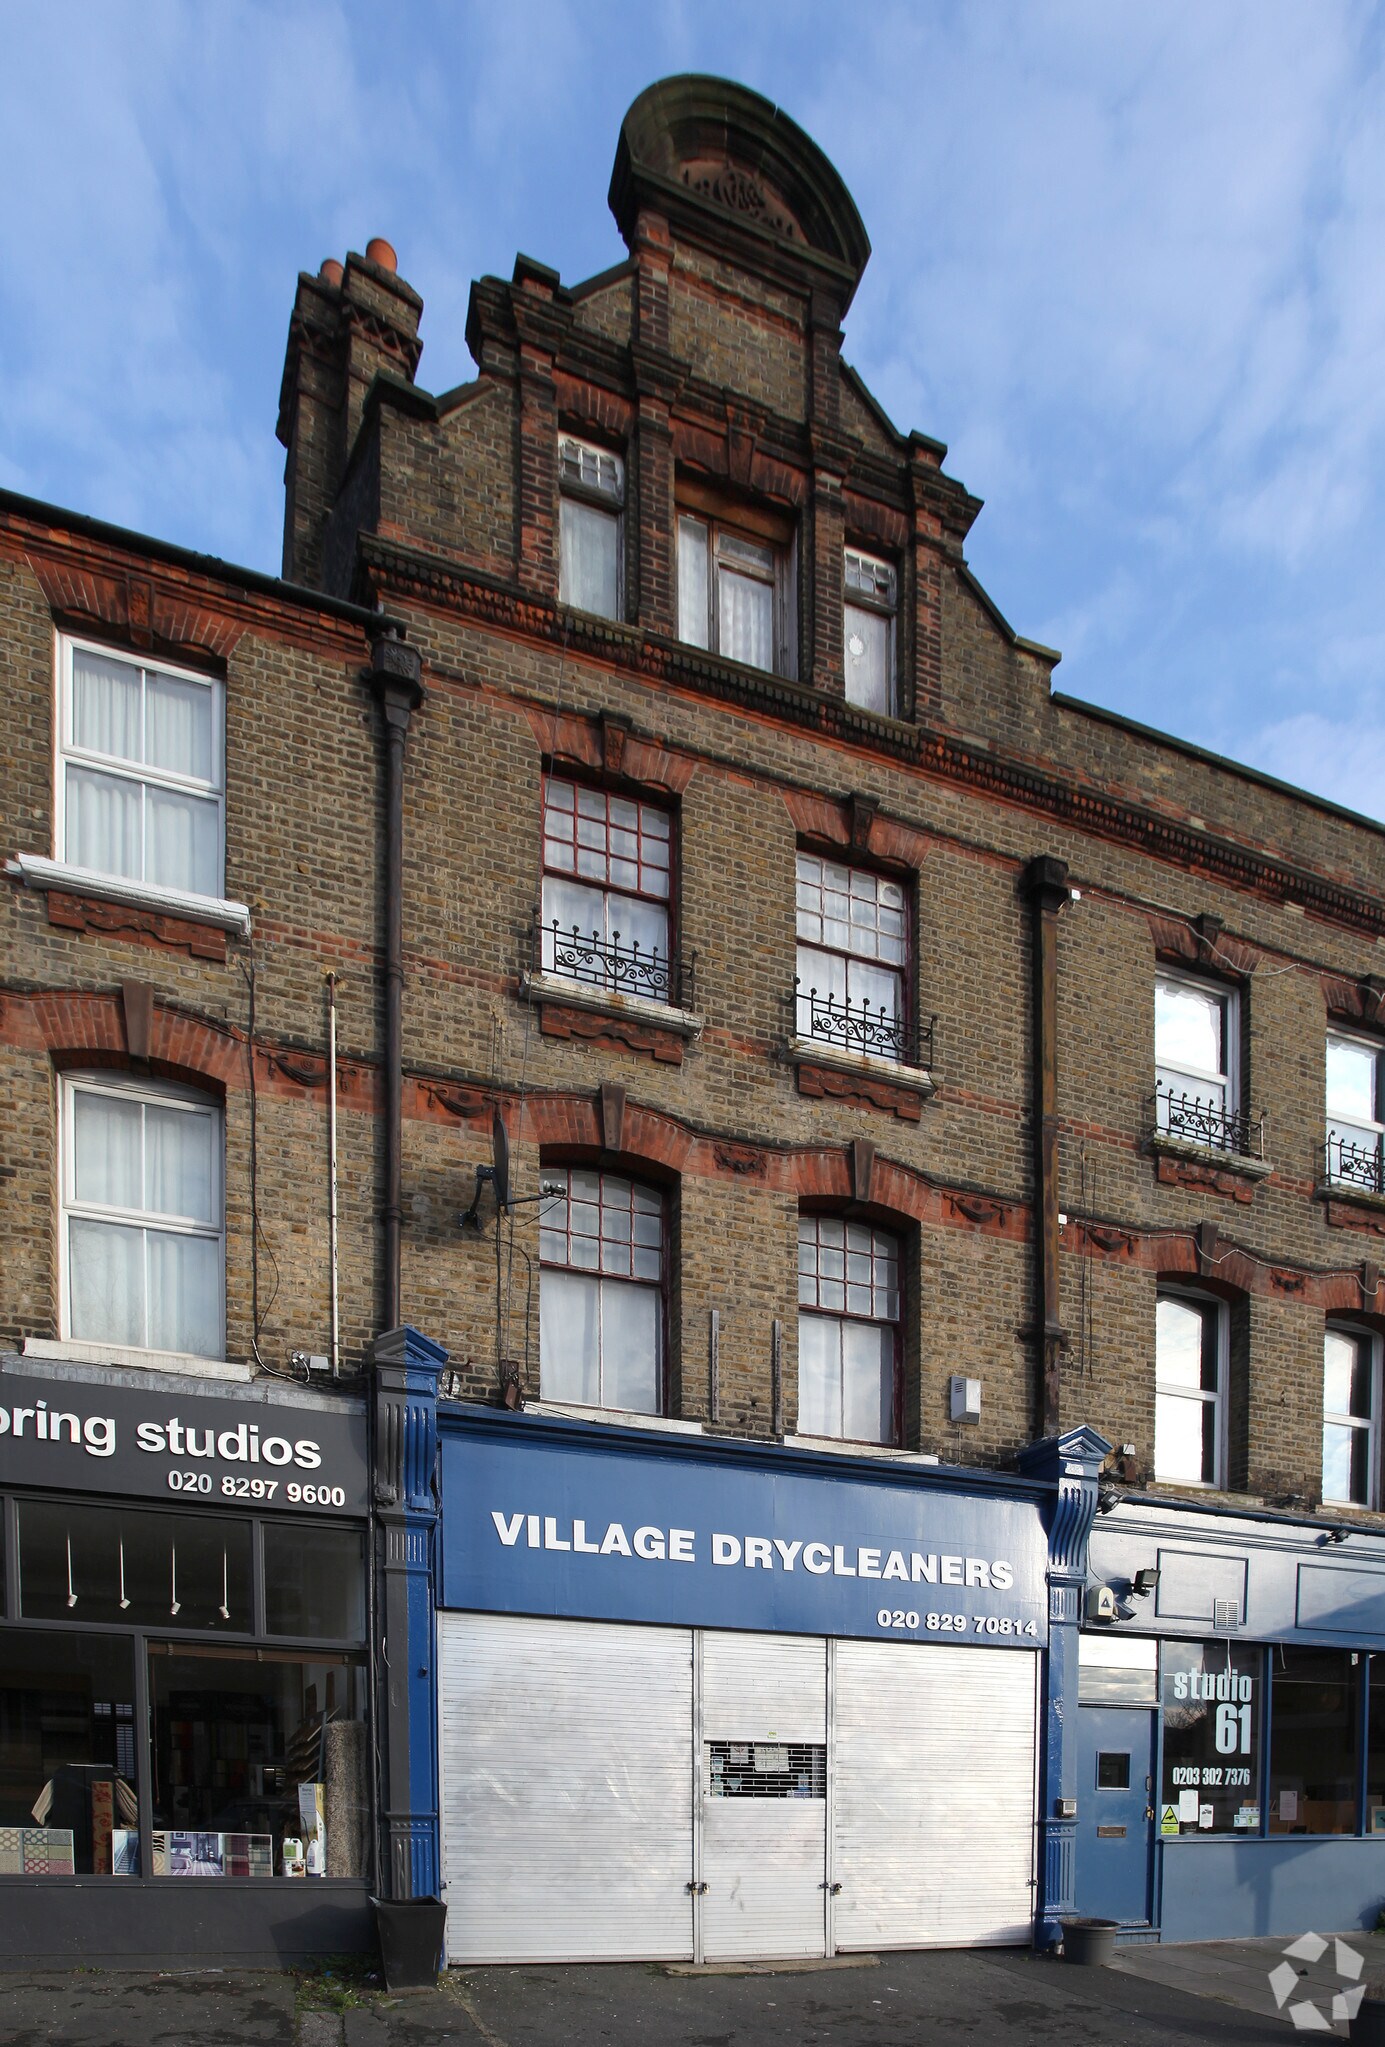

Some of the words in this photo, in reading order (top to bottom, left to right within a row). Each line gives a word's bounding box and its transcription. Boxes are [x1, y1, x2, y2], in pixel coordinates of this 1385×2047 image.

[136, 1417, 322, 1469] studios
[168, 1469, 213, 1494] 020
[221, 1475, 279, 1500] 8297
[286, 1482, 346, 1507] 9600
[491, 1511, 696, 1562] VILLAGE
[712, 1533, 1014, 1591] DRYCLEANERS
[877, 1609, 920, 1629] 020
[926, 1612, 968, 1632] 829
[973, 1615, 1038, 1637] 70814
[1174, 1667, 1253, 1702] studio
[1215, 1703, 1252, 1754] 61
[1172, 1766, 1201, 1786] 0203
[1202, 1767, 1223, 1786] 302
[1224, 1768, 1251, 1786] 7376
